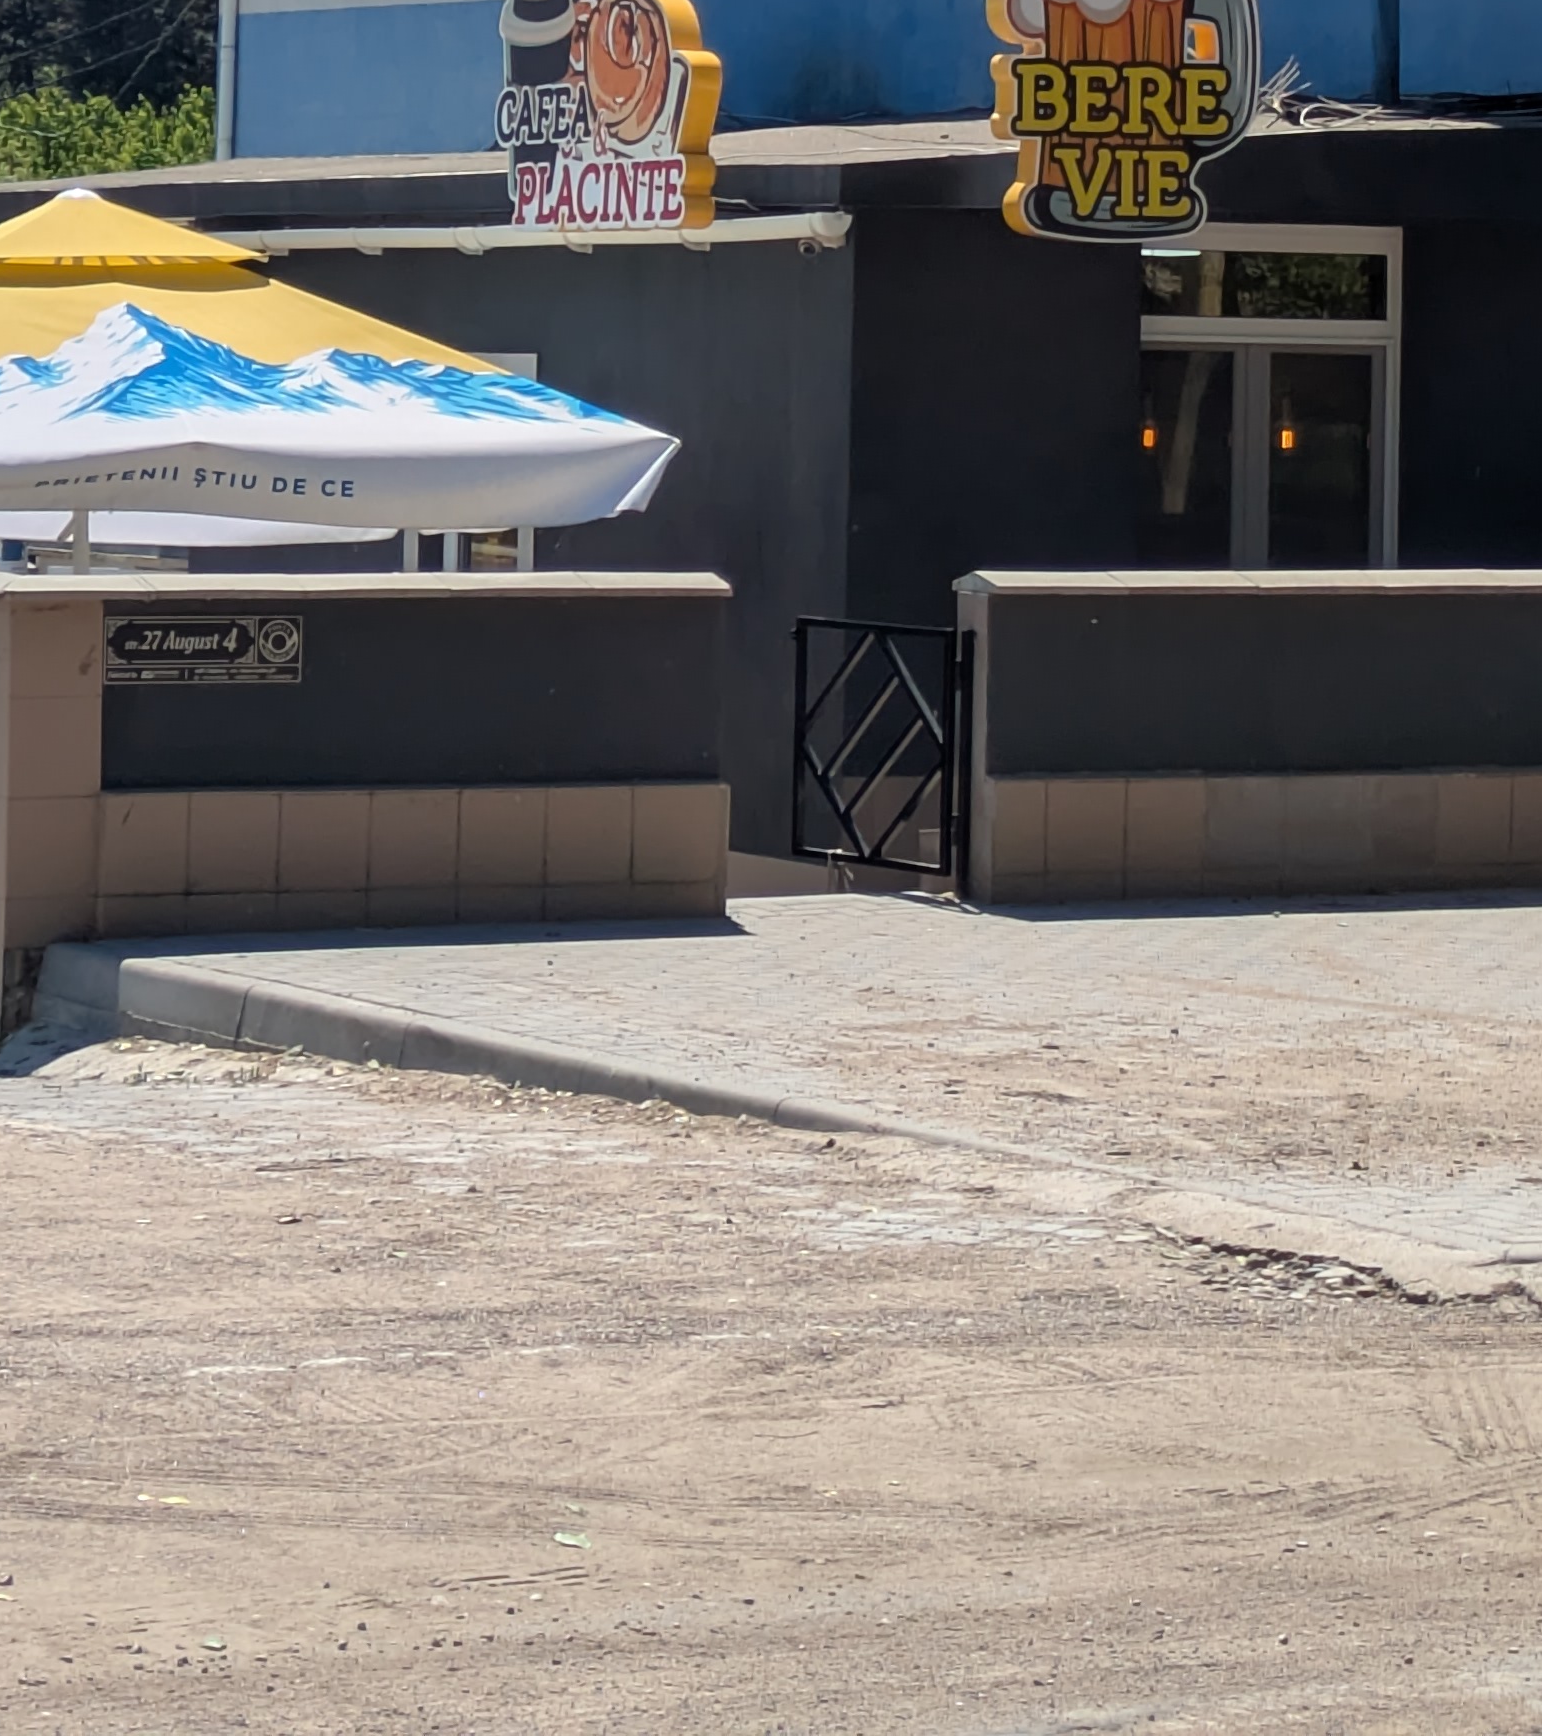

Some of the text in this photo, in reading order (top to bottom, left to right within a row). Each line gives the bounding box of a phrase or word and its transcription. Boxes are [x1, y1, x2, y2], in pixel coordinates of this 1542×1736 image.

[497, 87, 592, 144] CAFEA
[1015, 63, 1231, 136] BERE
[1054, 148, 1191, 217] VIE
[34, 466, 179, 488] PRIETENII
[271, 476, 307, 495] DE
[321, 479, 355, 498] CE
[162, 630, 220, 655] August
[222, 627, 239, 653] 4
